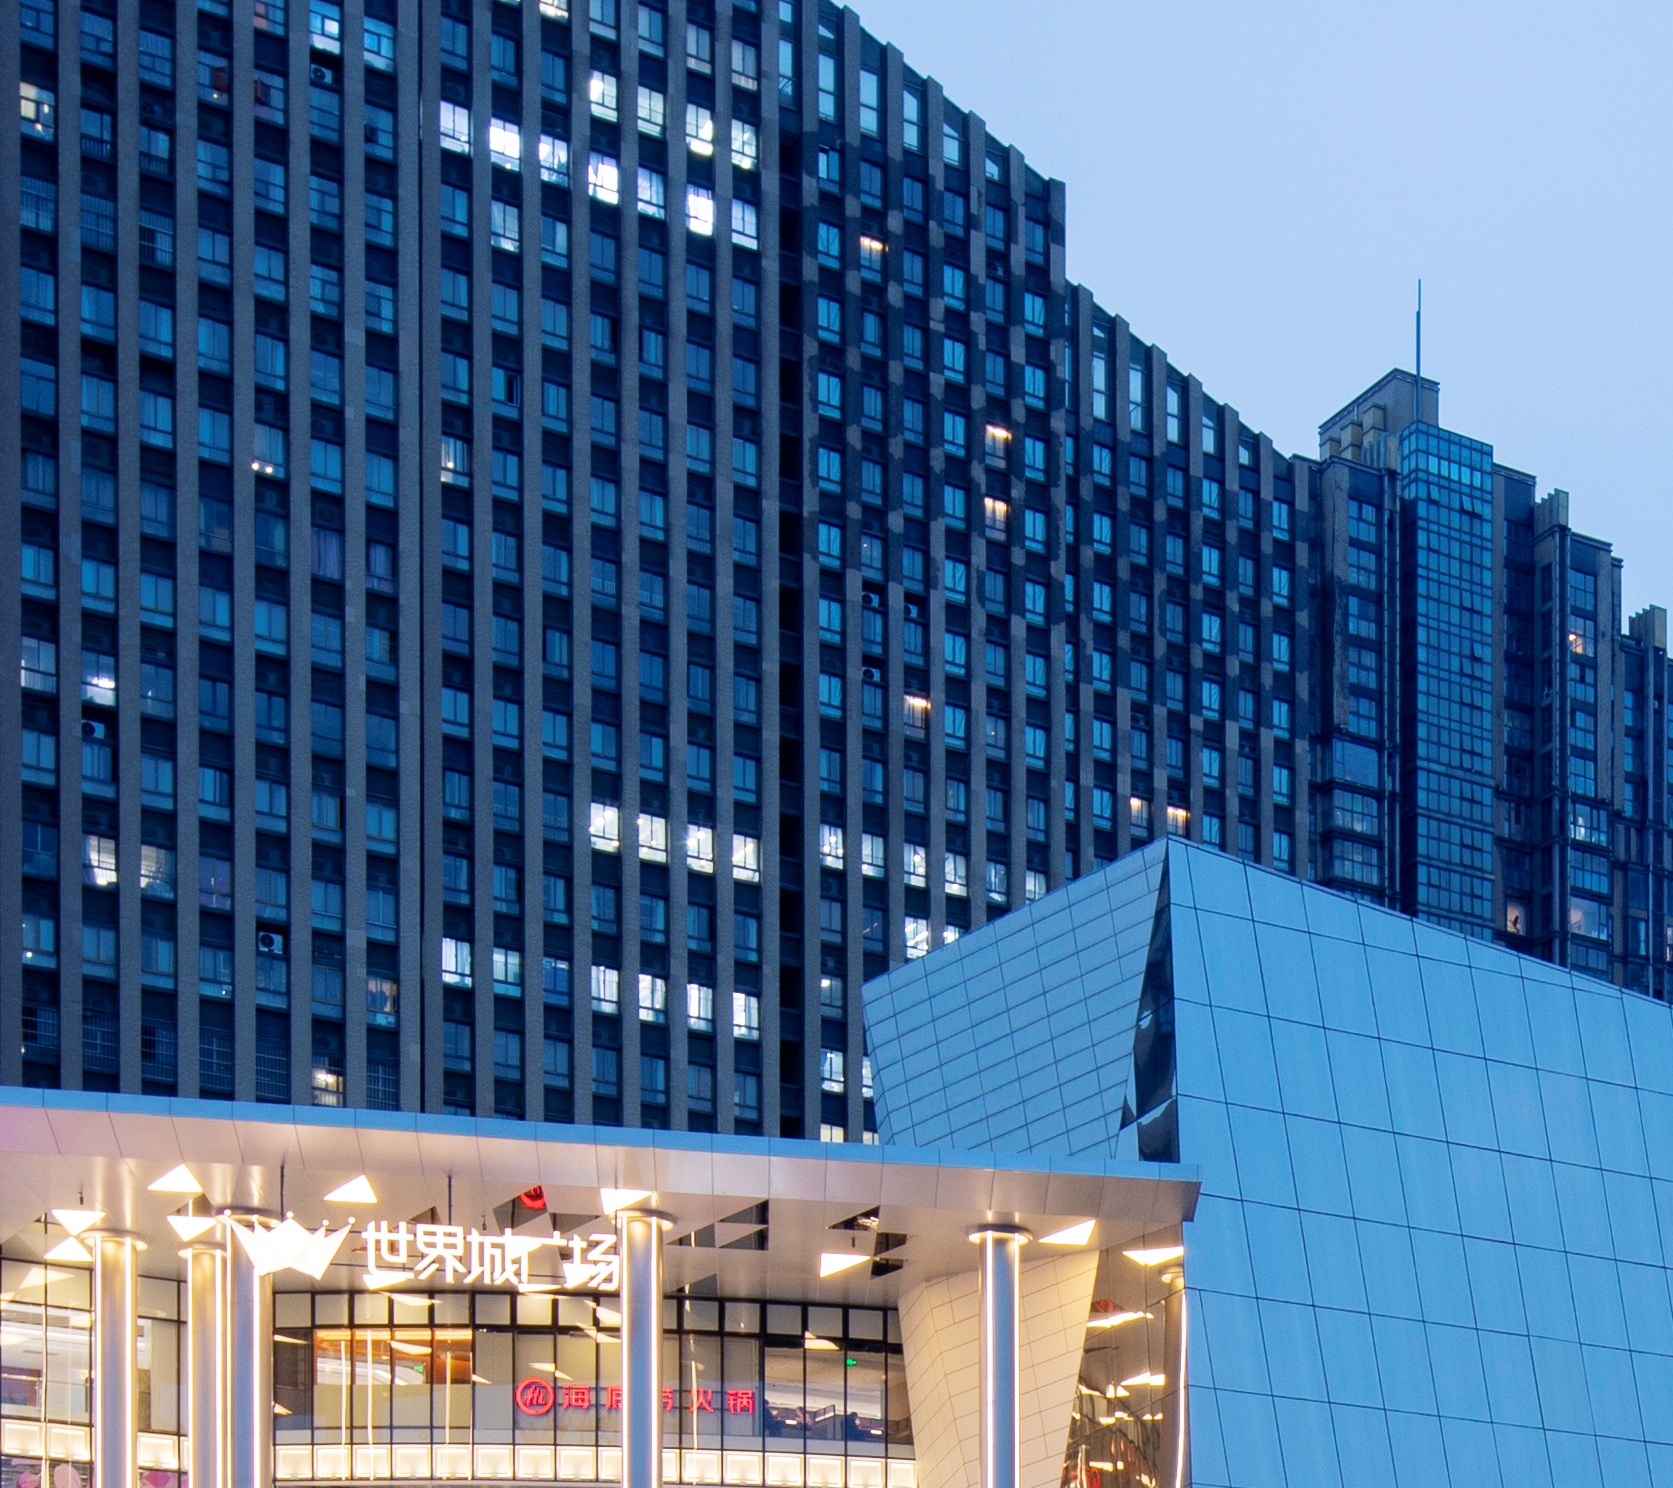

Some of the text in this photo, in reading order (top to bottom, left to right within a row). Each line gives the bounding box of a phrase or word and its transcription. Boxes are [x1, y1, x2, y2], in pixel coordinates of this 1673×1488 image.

[361, 1219, 621, 1291] 世界城广场
